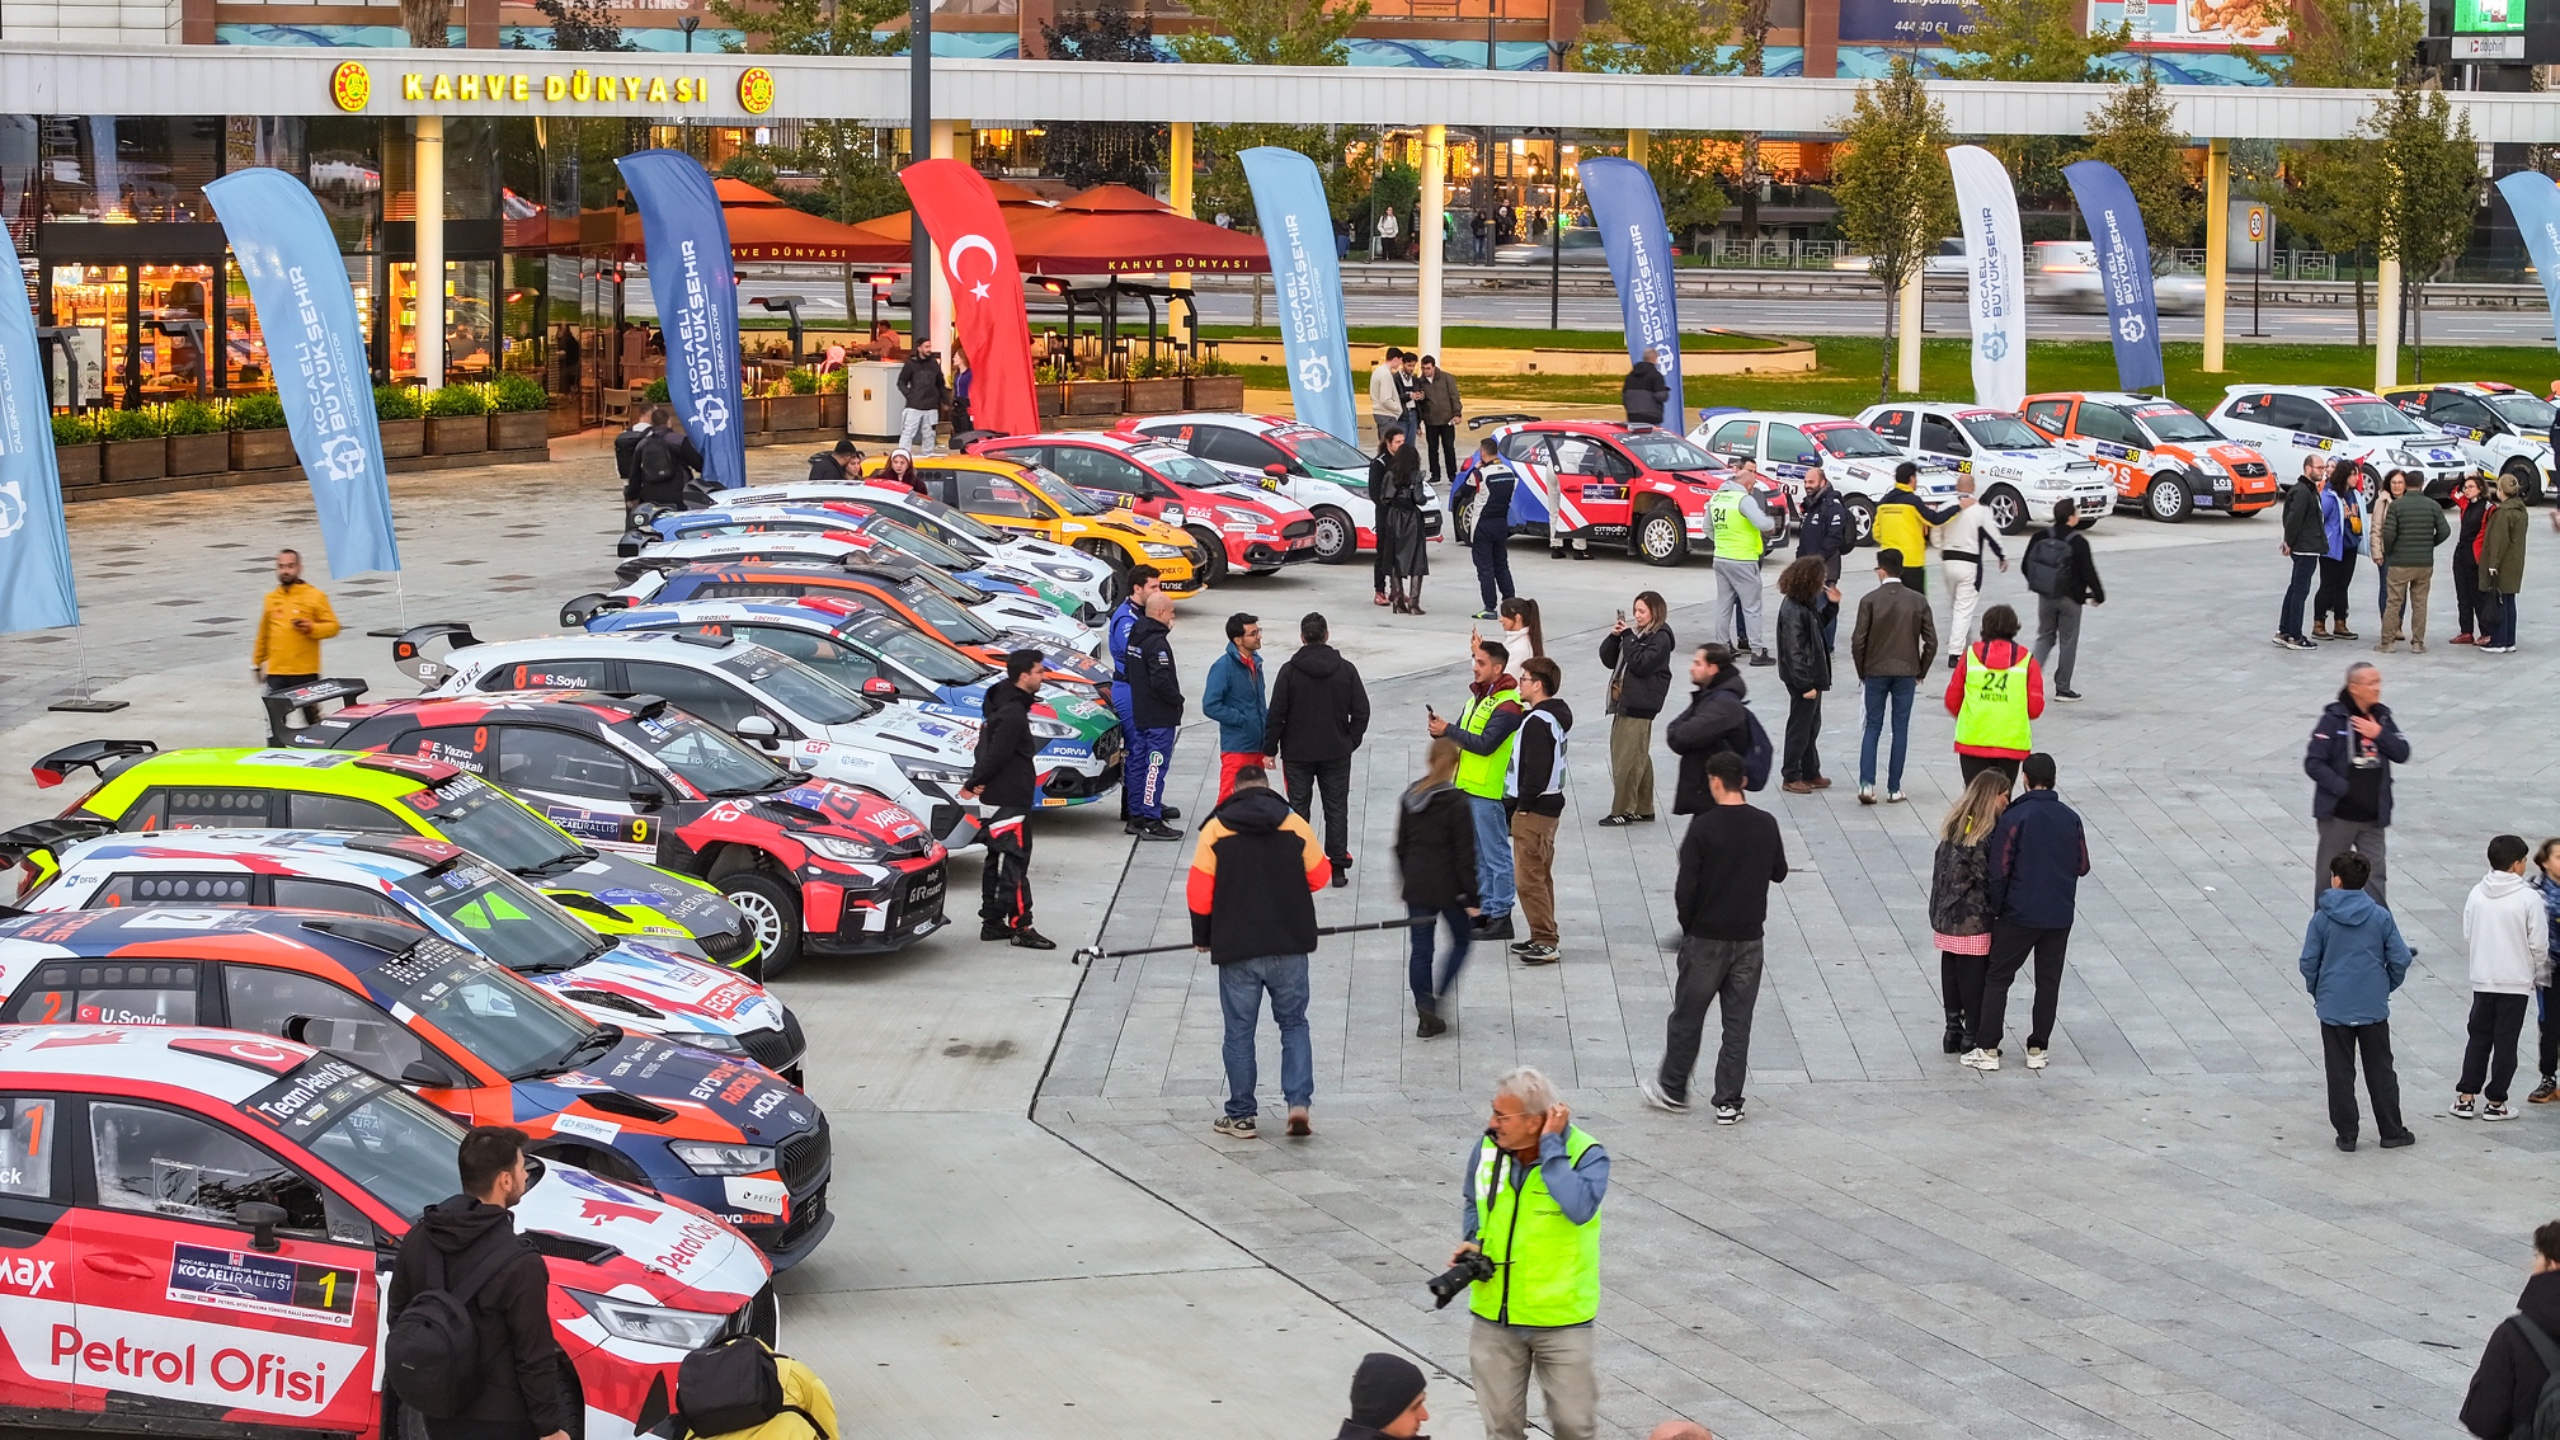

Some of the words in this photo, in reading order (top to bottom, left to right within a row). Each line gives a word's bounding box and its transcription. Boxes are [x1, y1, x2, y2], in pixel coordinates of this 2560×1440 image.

[403, 74, 529, 101] KAHVE
[546, 69, 707, 103] DÜNYASI
[771, 246, 847, 259] DÜNYASI
[1107, 260, 1165, 271] KAHVE
[1175, 257, 1249, 270] DÜNYASI
[1889, 412, 1904, 425] 36
[2469, 429, 2482, 440] 32
[2318, 439, 2332, 451] 43
[2125, 449, 2139, 461] 38
[1958, 460, 1972, 473] 36
[1260, 478, 1276, 491] 29
[1619, 486, 1628, 499] 7
[1118, 495, 1134, 508] 11
[1713, 508, 1726, 522] 34
[947, 538, 957, 546] 10
[514, 664, 528, 689] 8
[545, 673, 588, 689] S.Soylu
[1982, 672, 2009, 692] 24
[473, 726, 488, 753] 9
[1054, 747, 1087, 756] FORVIA
[1144, 764, 1160, 806] Castrol
[632, 819, 648, 842] 9
[41, 991, 63, 1025] 2
[294, 1066, 342, 1095] Petrol
[258, 1085, 315, 1120] Team
[246, 1104, 280, 1126] 1
[25, 1104, 45, 1157] 1
[753, 1194, 781, 1205] PETKIT
[655, 1230, 707, 1275] Petrol
[319, 1271, 337, 1308] 1
[51, 1323, 196, 1386] Petrol
[210, 1347, 325, 1404] Ofisi
